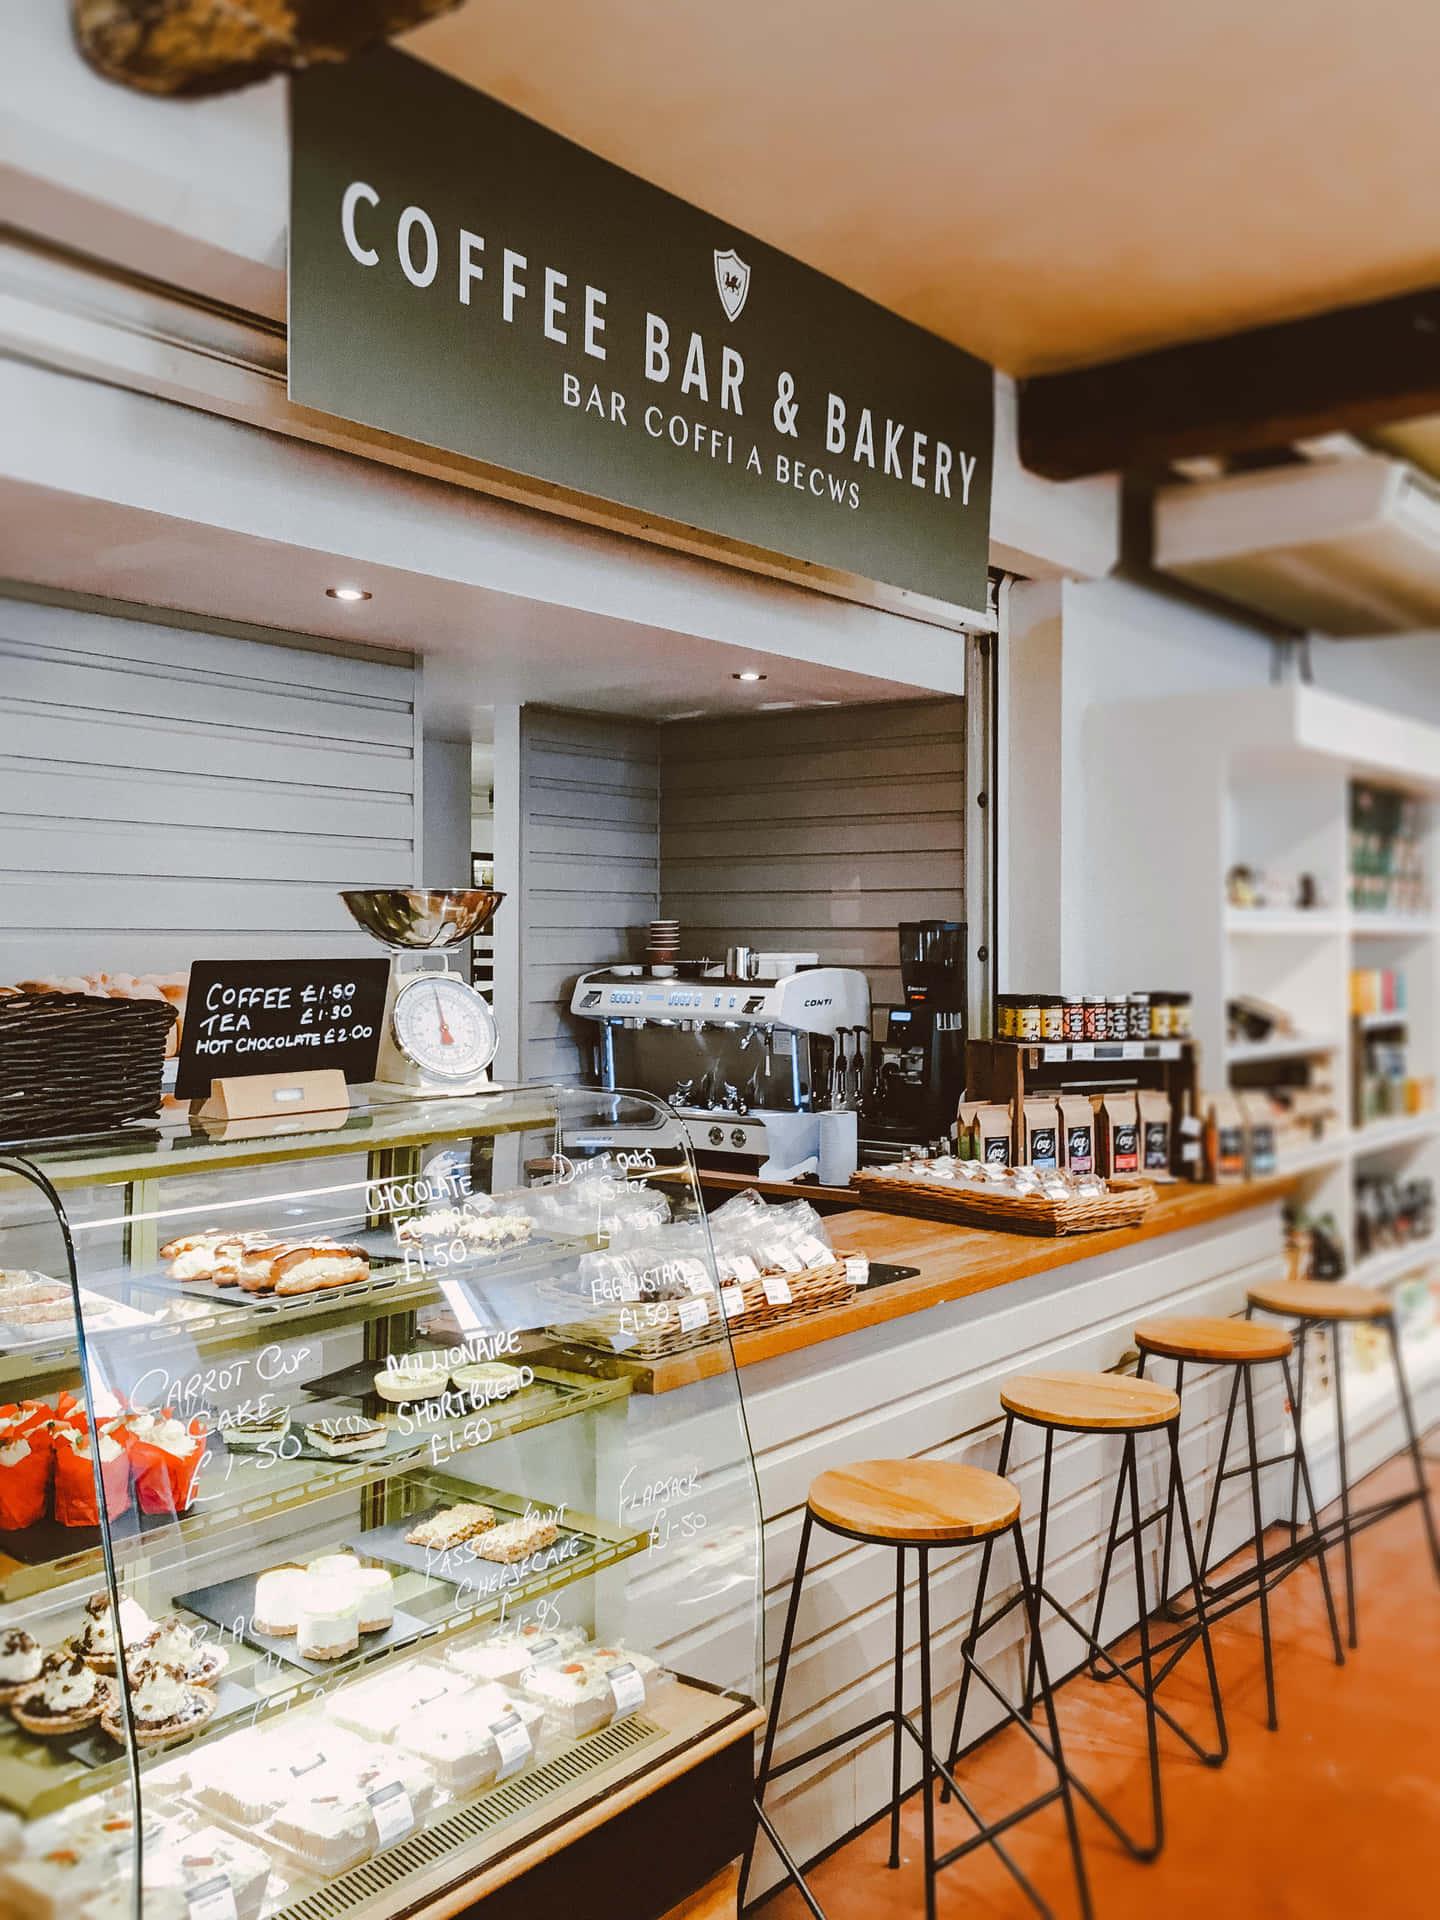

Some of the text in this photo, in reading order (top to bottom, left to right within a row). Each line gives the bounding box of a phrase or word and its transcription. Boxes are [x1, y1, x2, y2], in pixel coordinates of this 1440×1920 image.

[342, 182, 976, 506] COFFEE BAR & BAKERY
[563, 373, 859, 509] BAR COFFI A BECWS
[206, 983, 292, 1011] COFFEE
[804, 998, 833, 1007] CONTI
[195, 1039, 233, 1055] HOT
[235, 1033, 320, 1053] CHOCOLATE
[200, 1014, 251, 1036] TEA
[552, 1153, 594, 1184] DATE
[366, 1175, 474, 1212] CHOCOLATE
[401, 1239, 467, 1281] £1.50
[591, 1275, 624, 1305] EGG
[620, 1303, 669, 1336] £1.50
[386, 1327, 523, 1379] MILLIONAIRE
[130, 1345, 311, 1414] CARROT CUP
[187, 1394, 276, 1439] CAKE
[431, 1418, 493, 1466] £1.50
[455, 1533, 584, 1612] CHEESECAKE
